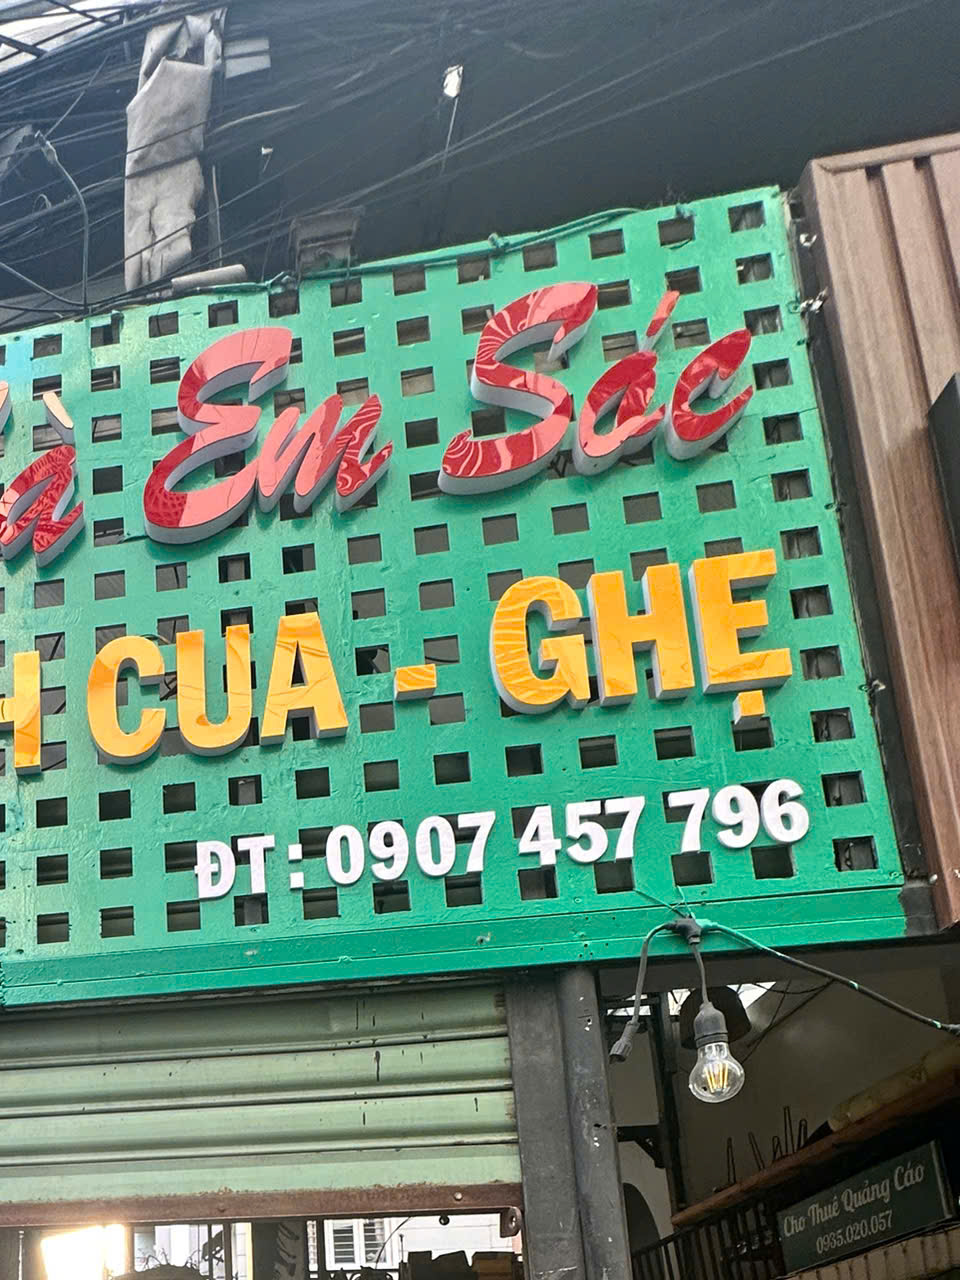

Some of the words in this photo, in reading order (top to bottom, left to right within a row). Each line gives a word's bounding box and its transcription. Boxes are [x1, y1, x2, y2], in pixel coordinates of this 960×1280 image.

[143, 327, 392, 544] Em
[86, 612, 349, 764] CUA
[490, 549, 792, 725] GHẸ
[325, 811, 496, 886] 0907
[518, 796, 646, 866] 457
[667, 778, 810, 853] 796
[783, 1211, 807, 1237] Cho
[808, 1196, 841, 1227] Thuê
[841, 1180, 890, 1213] Quảng
[893, 1161, 925, 1192] Cáo
